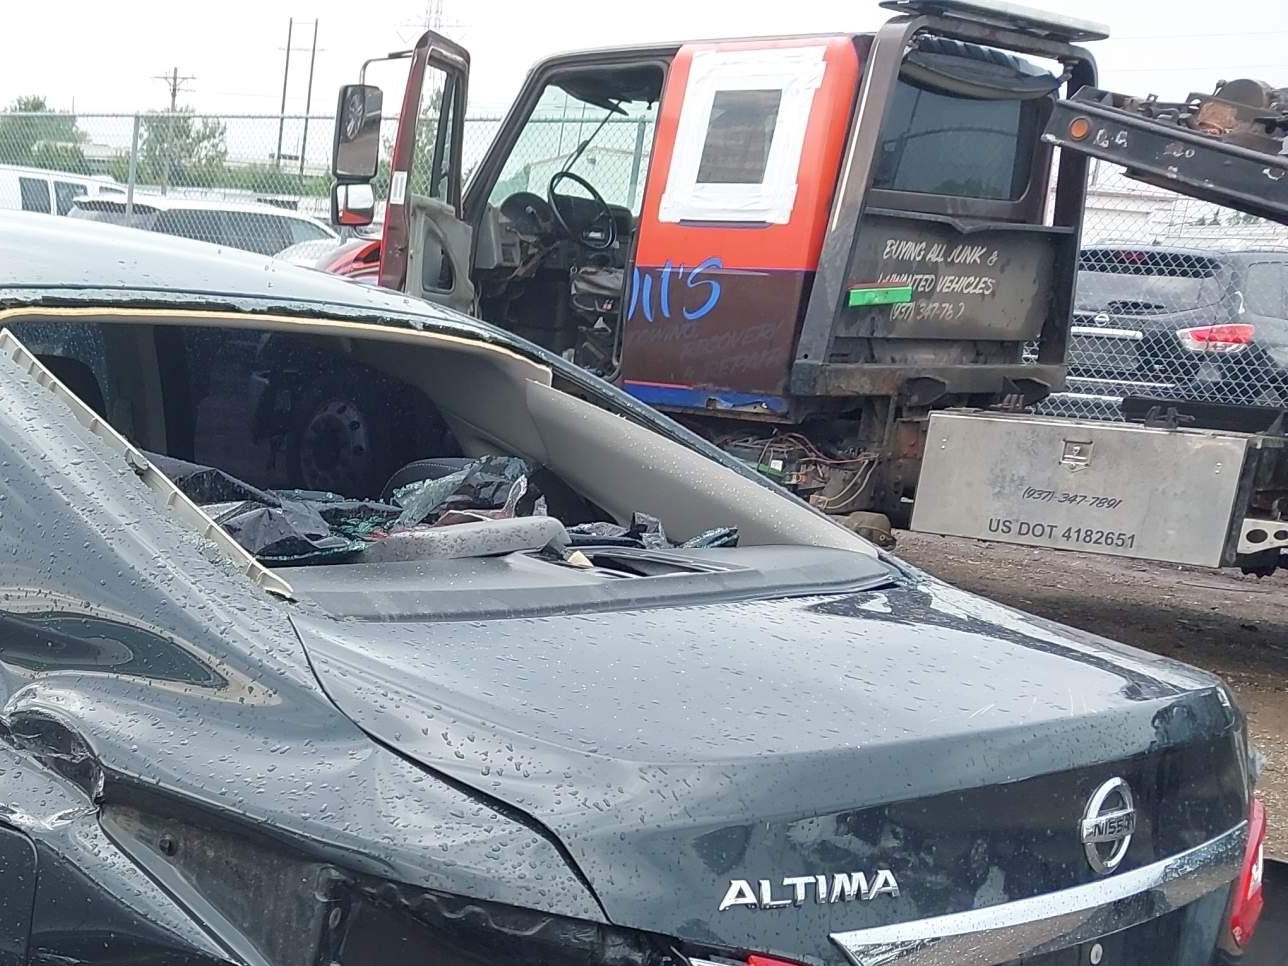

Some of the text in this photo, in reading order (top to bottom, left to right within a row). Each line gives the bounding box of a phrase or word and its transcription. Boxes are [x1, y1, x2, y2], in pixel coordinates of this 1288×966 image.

[883, 239, 999, 266] BUYING ALL JUNK &
[936, 275, 996, 295] VEHICLES
[1022, 486, 1123, 510] (937)-347-7891
[988, 518, 1136, 549] US DOT 4182651
[719, 868, 900, 912] ALTIMA
